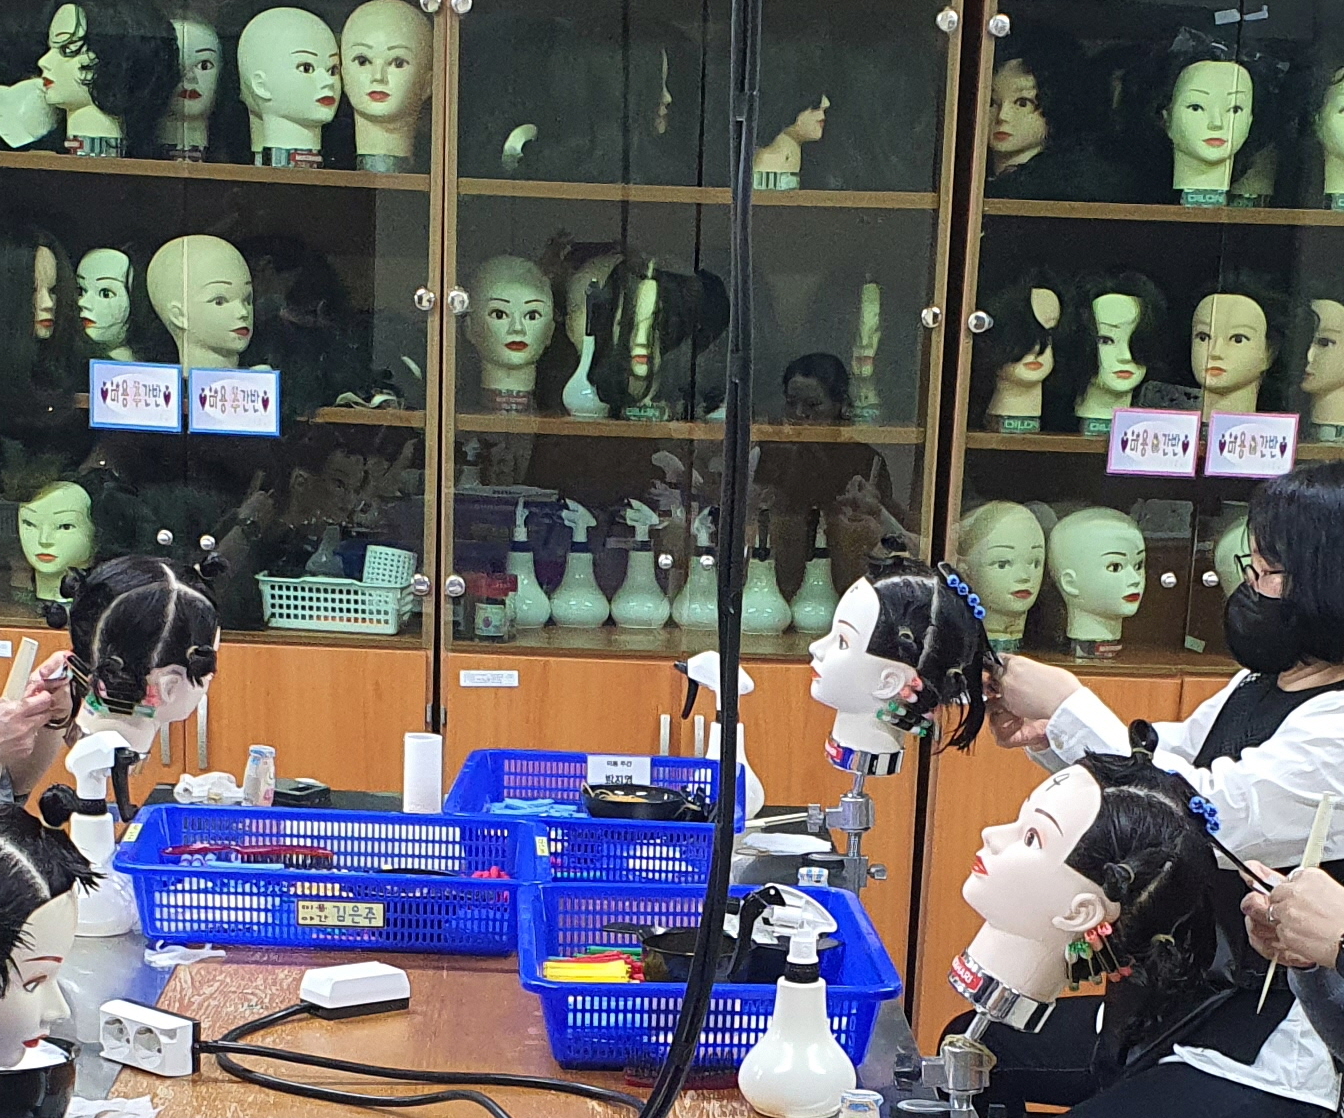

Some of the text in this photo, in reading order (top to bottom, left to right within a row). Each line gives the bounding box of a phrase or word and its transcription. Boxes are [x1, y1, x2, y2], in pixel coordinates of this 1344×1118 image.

[301, 903, 328, 913] 미용
[301, 904, 377, 925] 야간 김은주
